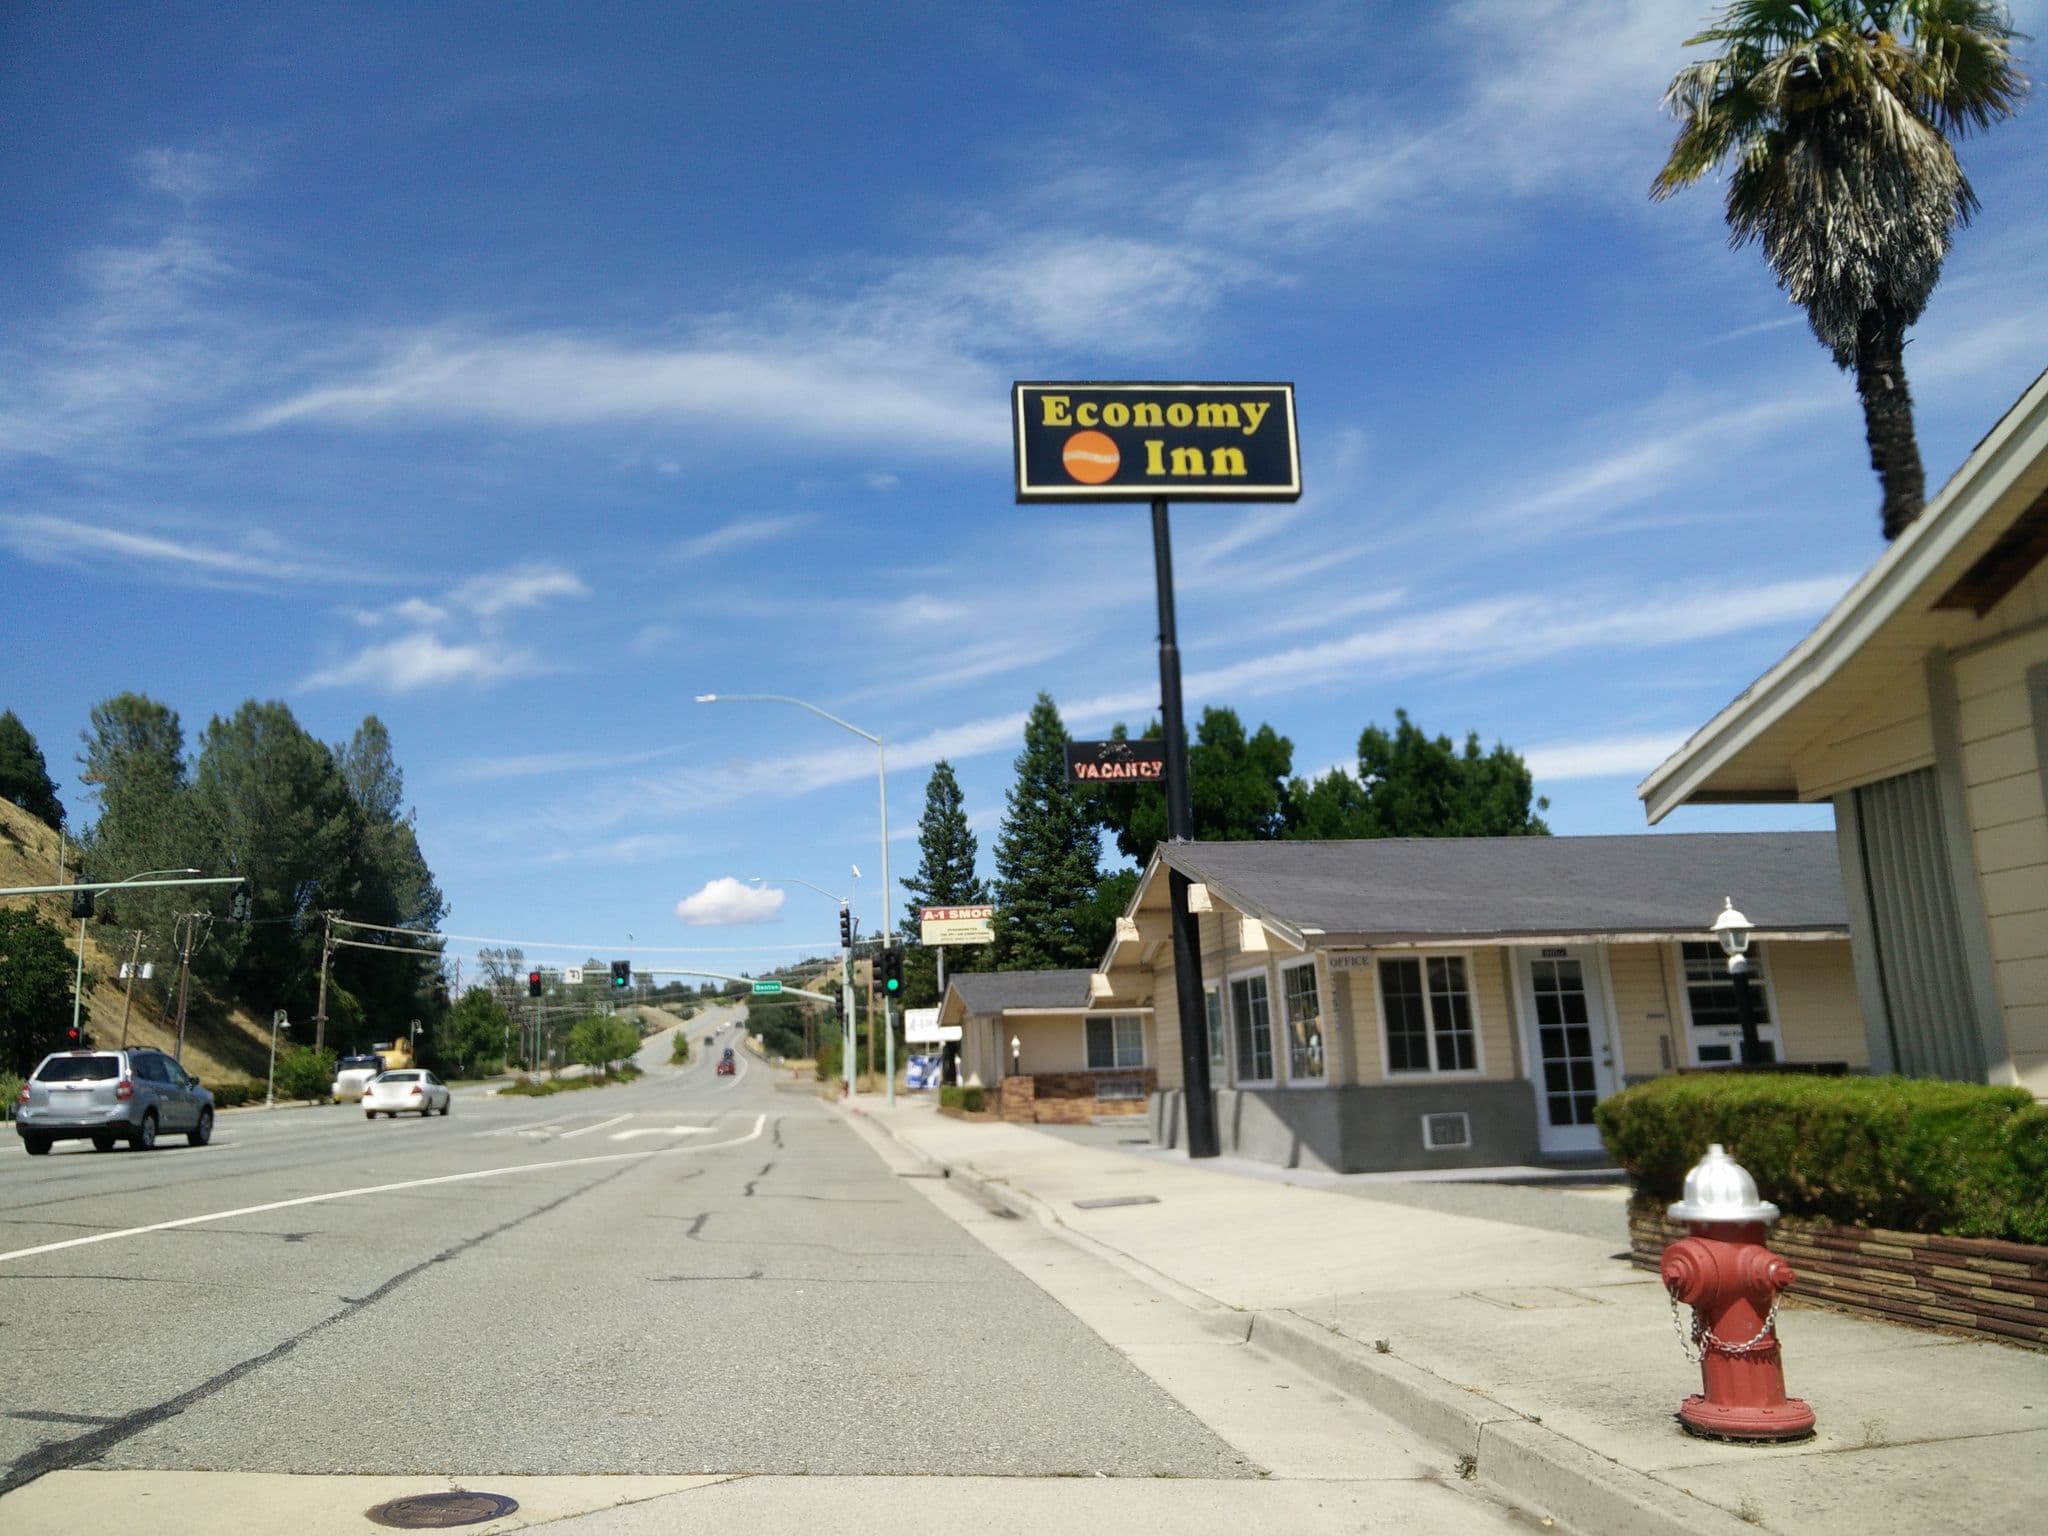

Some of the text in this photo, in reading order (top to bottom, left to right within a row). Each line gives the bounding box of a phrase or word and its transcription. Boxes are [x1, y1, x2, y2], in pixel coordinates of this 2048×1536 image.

[1041, 395, 1271, 435] Economy
[1144, 440, 1248, 476] Inn
[1074, 761, 1163, 779] VACANCY
[924, 910, 945, 920] A-1
[1330, 956, 1369, 968] OFFICE
